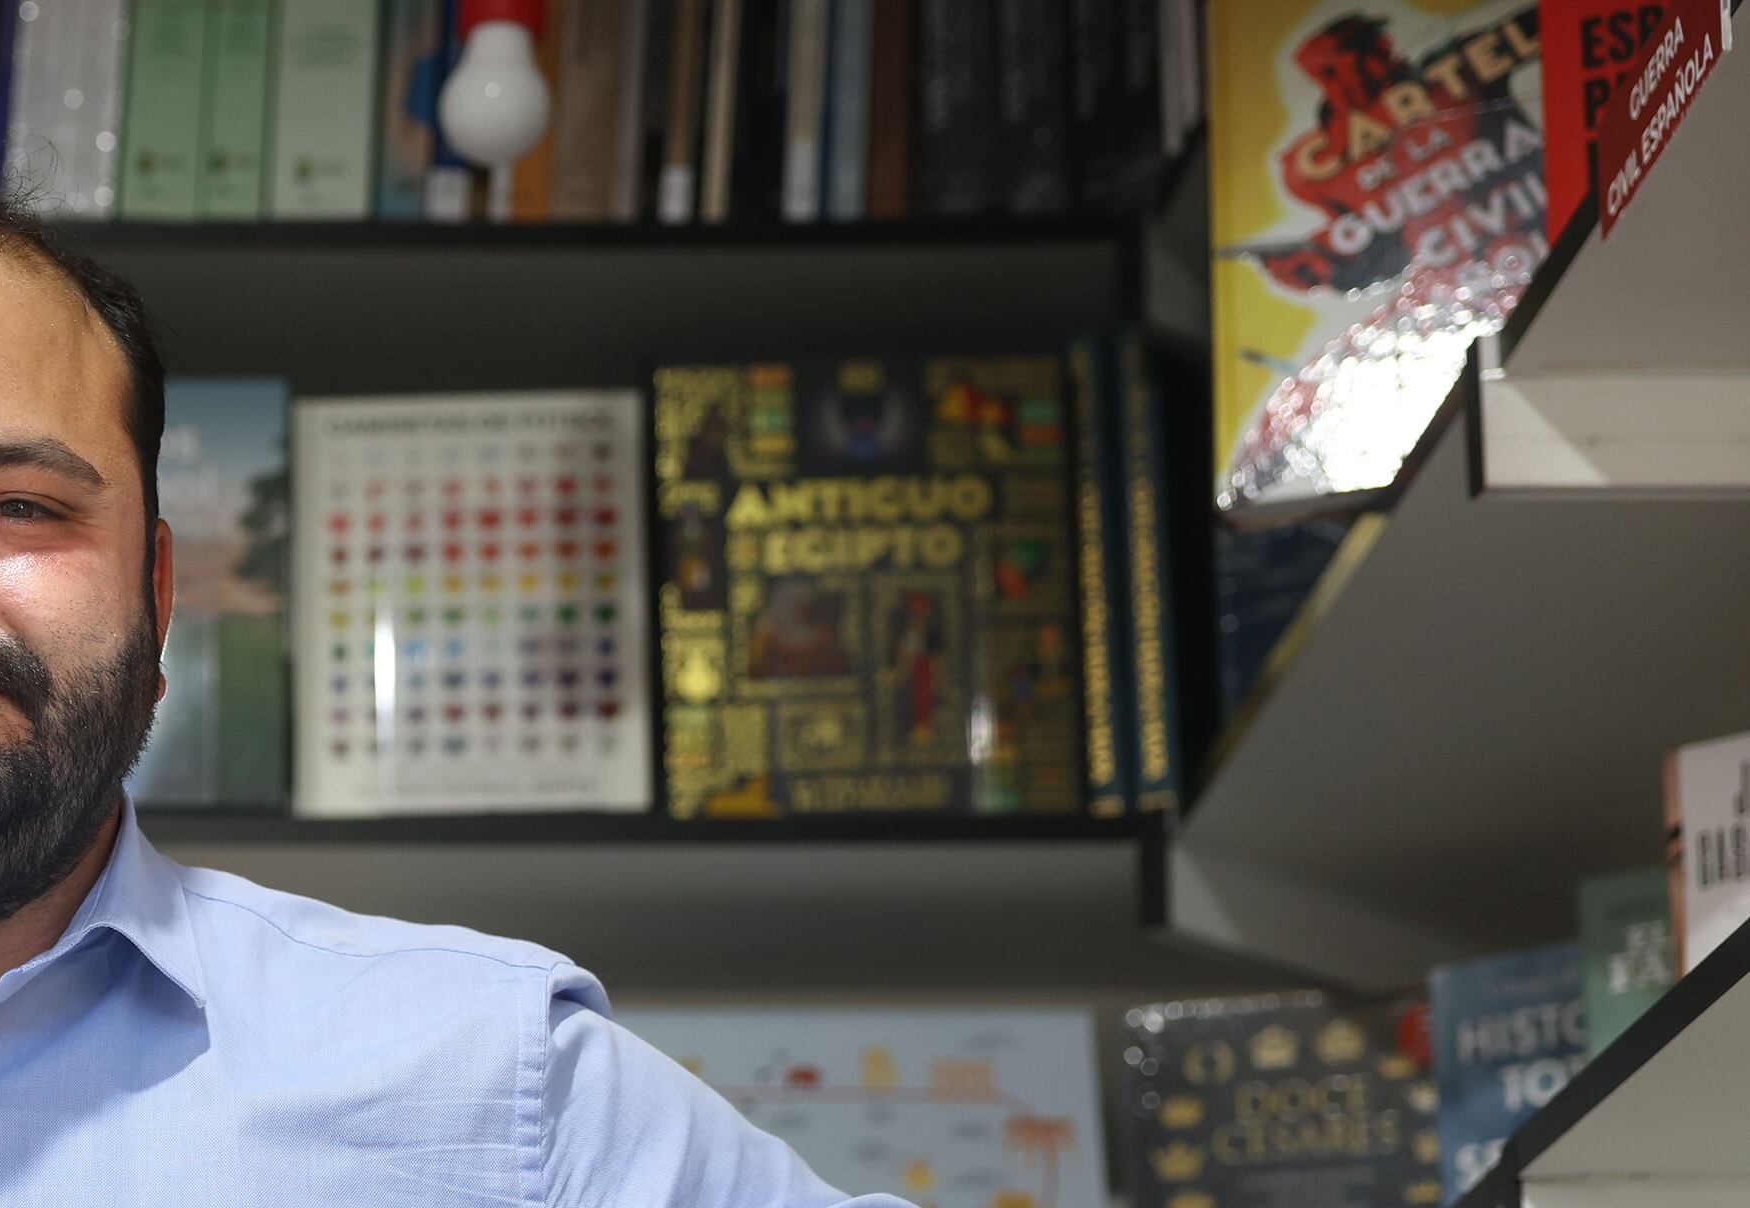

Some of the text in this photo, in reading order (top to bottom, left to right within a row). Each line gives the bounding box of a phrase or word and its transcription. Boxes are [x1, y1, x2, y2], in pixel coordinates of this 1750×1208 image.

[1607, 32, 1714, 216] CIVIL ESPAÑOLA
[1630, 16, 1684, 120] GUERRA
[1330, 117, 1541, 255] GUERRA
[727, 474, 994, 527] ANTIGUO
